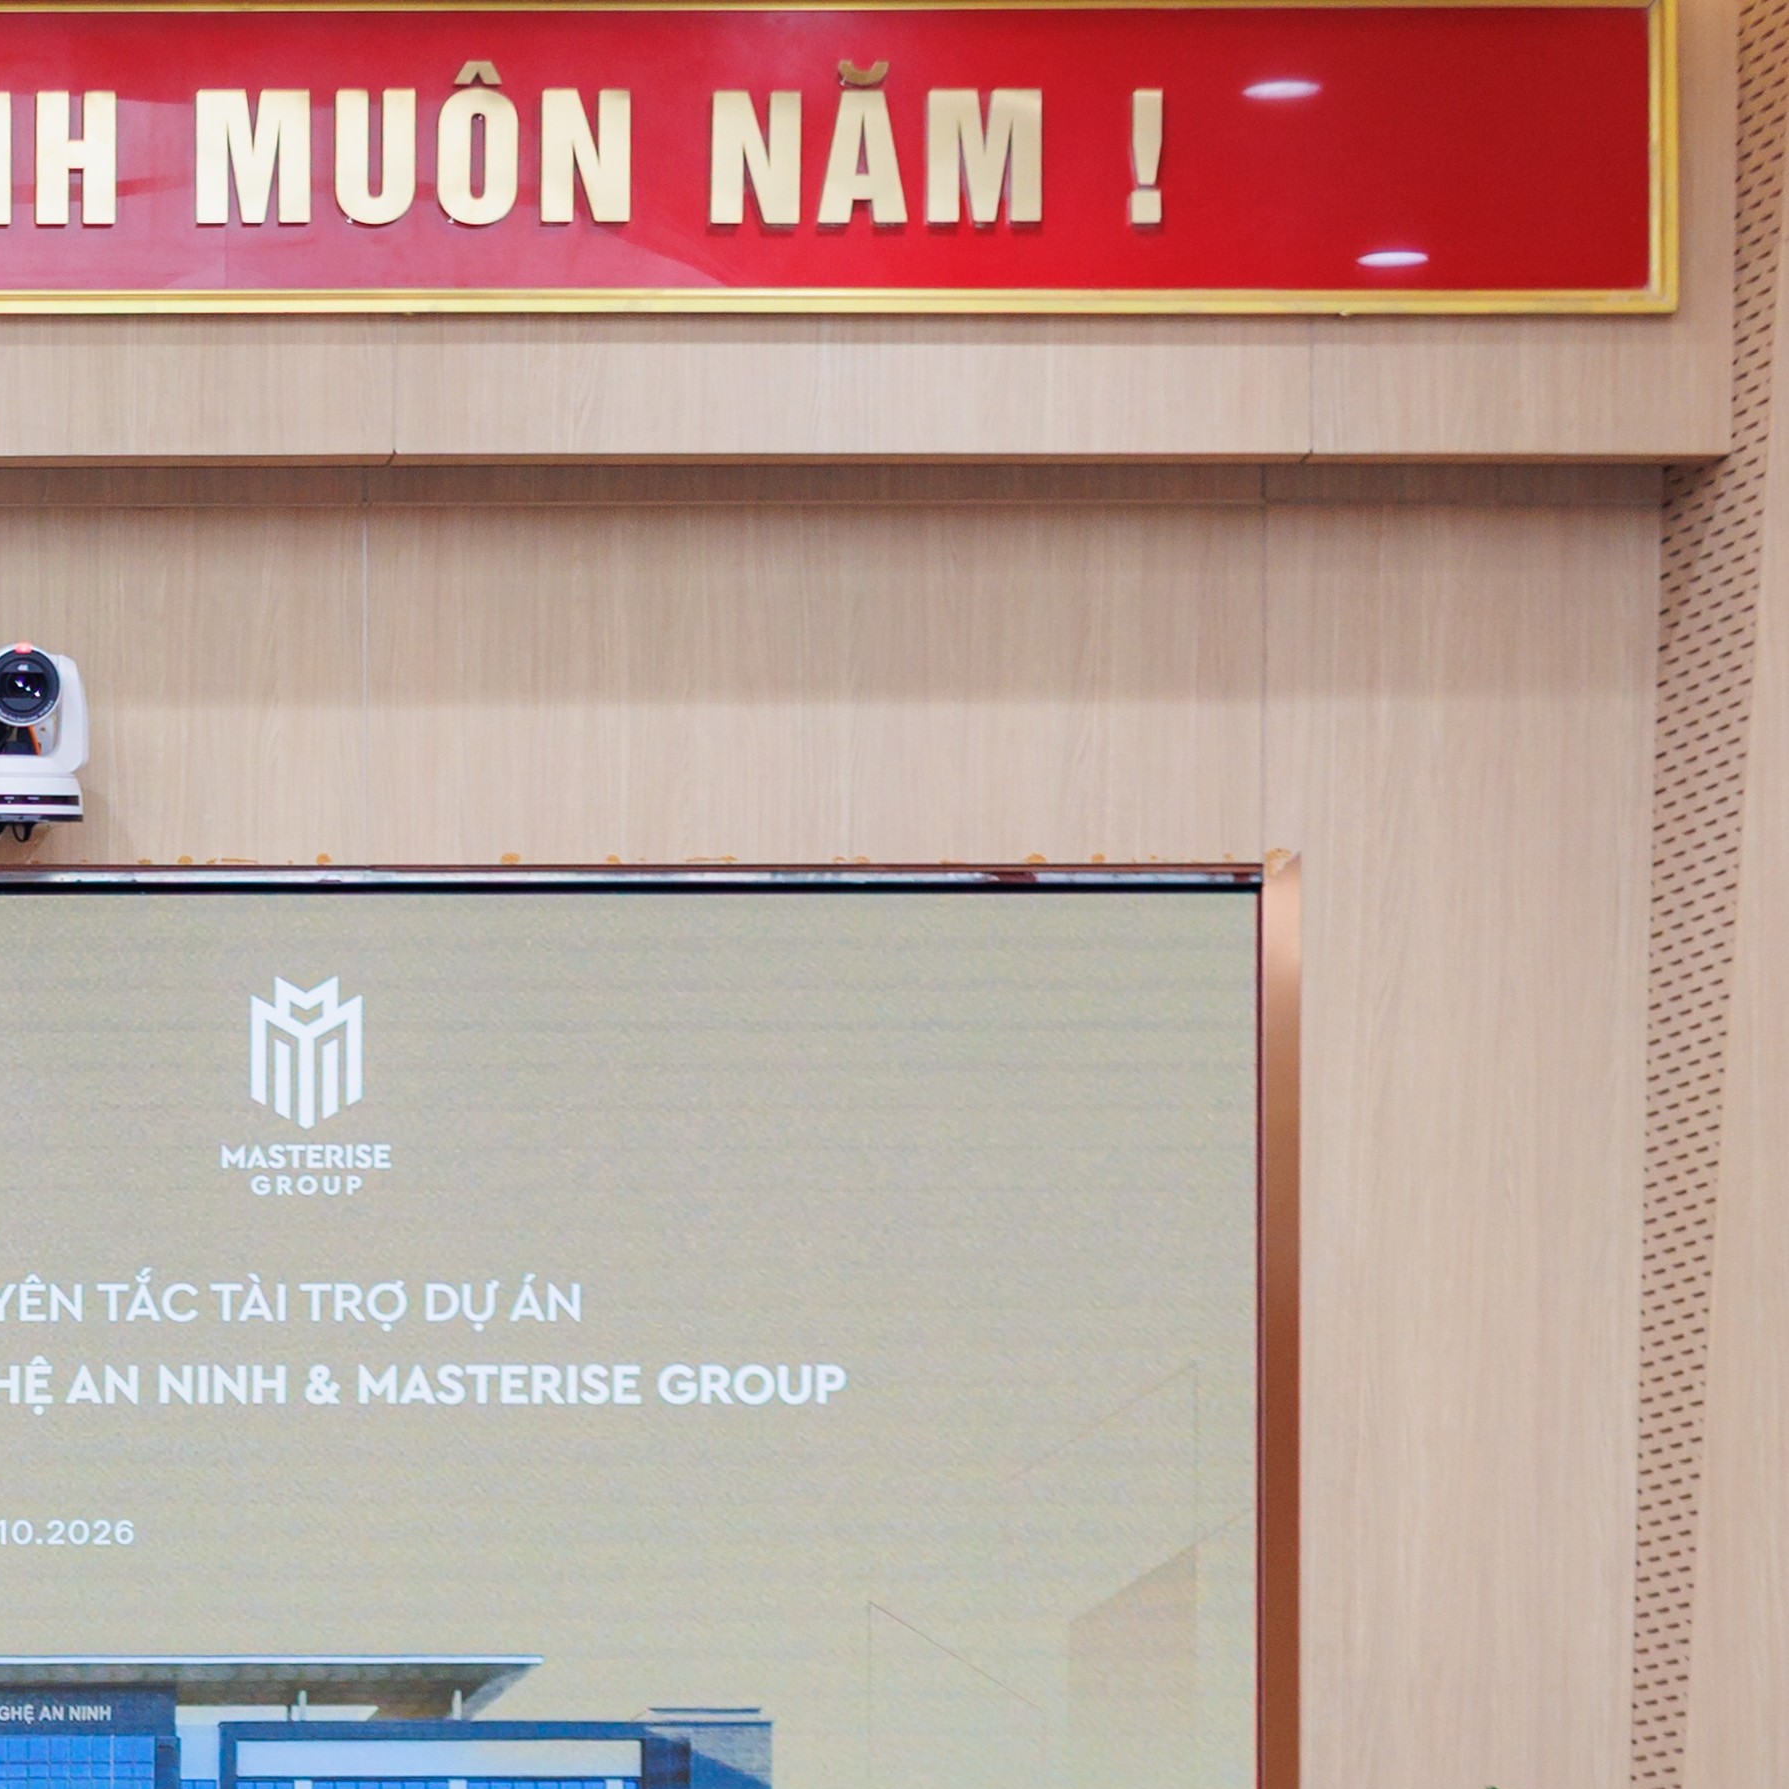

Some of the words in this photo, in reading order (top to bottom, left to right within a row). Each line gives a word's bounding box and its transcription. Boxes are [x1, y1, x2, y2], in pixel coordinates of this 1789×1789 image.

[196, 60, 633, 228] MUÔN
[708, 60, 1045, 228] NĂM
[1128, 87, 1164, 226] !
[221, 1143, 392, 1169] MASTERISE
[251, 1174, 363, 1196] GROUP
[97, 1267, 199, 1323] TẮC
[210, 1272, 287, 1322] TÀI
[300, 1279, 408, 1332] TRỢ
[425, 1279, 500, 1332] DỰ
[510, 1273, 581, 1322] ÁN
[67, 1364, 139, 1405] AN
[159, 1364, 287, 1405] NINH
[306, 1364, 341, 1405] &
[359, 1363, 642, 1405] MASTERISE
[658, 1364, 846, 1405] GROUP
[39, 1705, 65, 1722] AN
[69, 1705, 112, 1722] NINH
